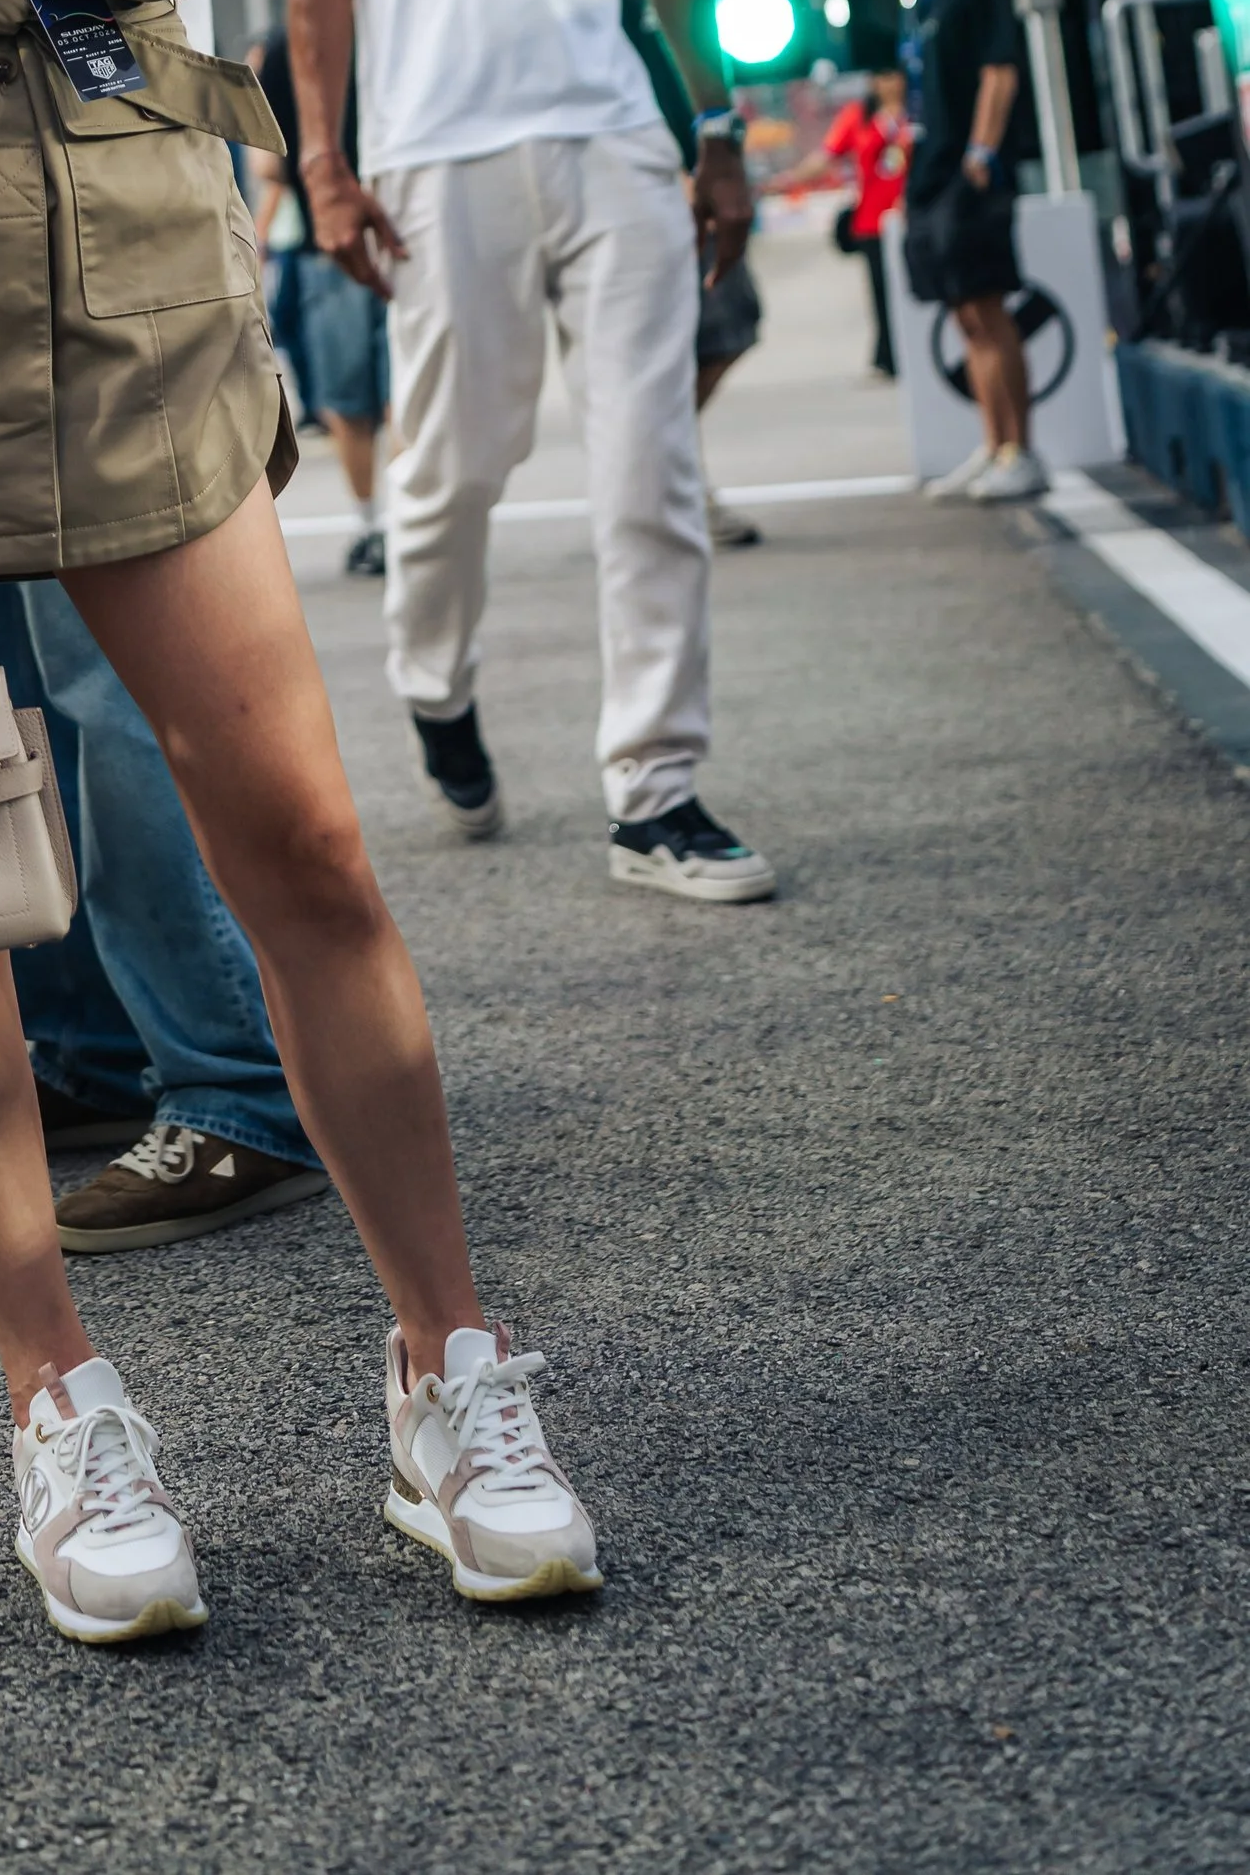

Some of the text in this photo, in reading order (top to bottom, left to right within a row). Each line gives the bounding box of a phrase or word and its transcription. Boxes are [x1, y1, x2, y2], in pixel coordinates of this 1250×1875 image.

[60, 24, 106, 39] SUNDAY
[93, 28, 116, 39] 2025
[89, 58, 111, 69] TAG
